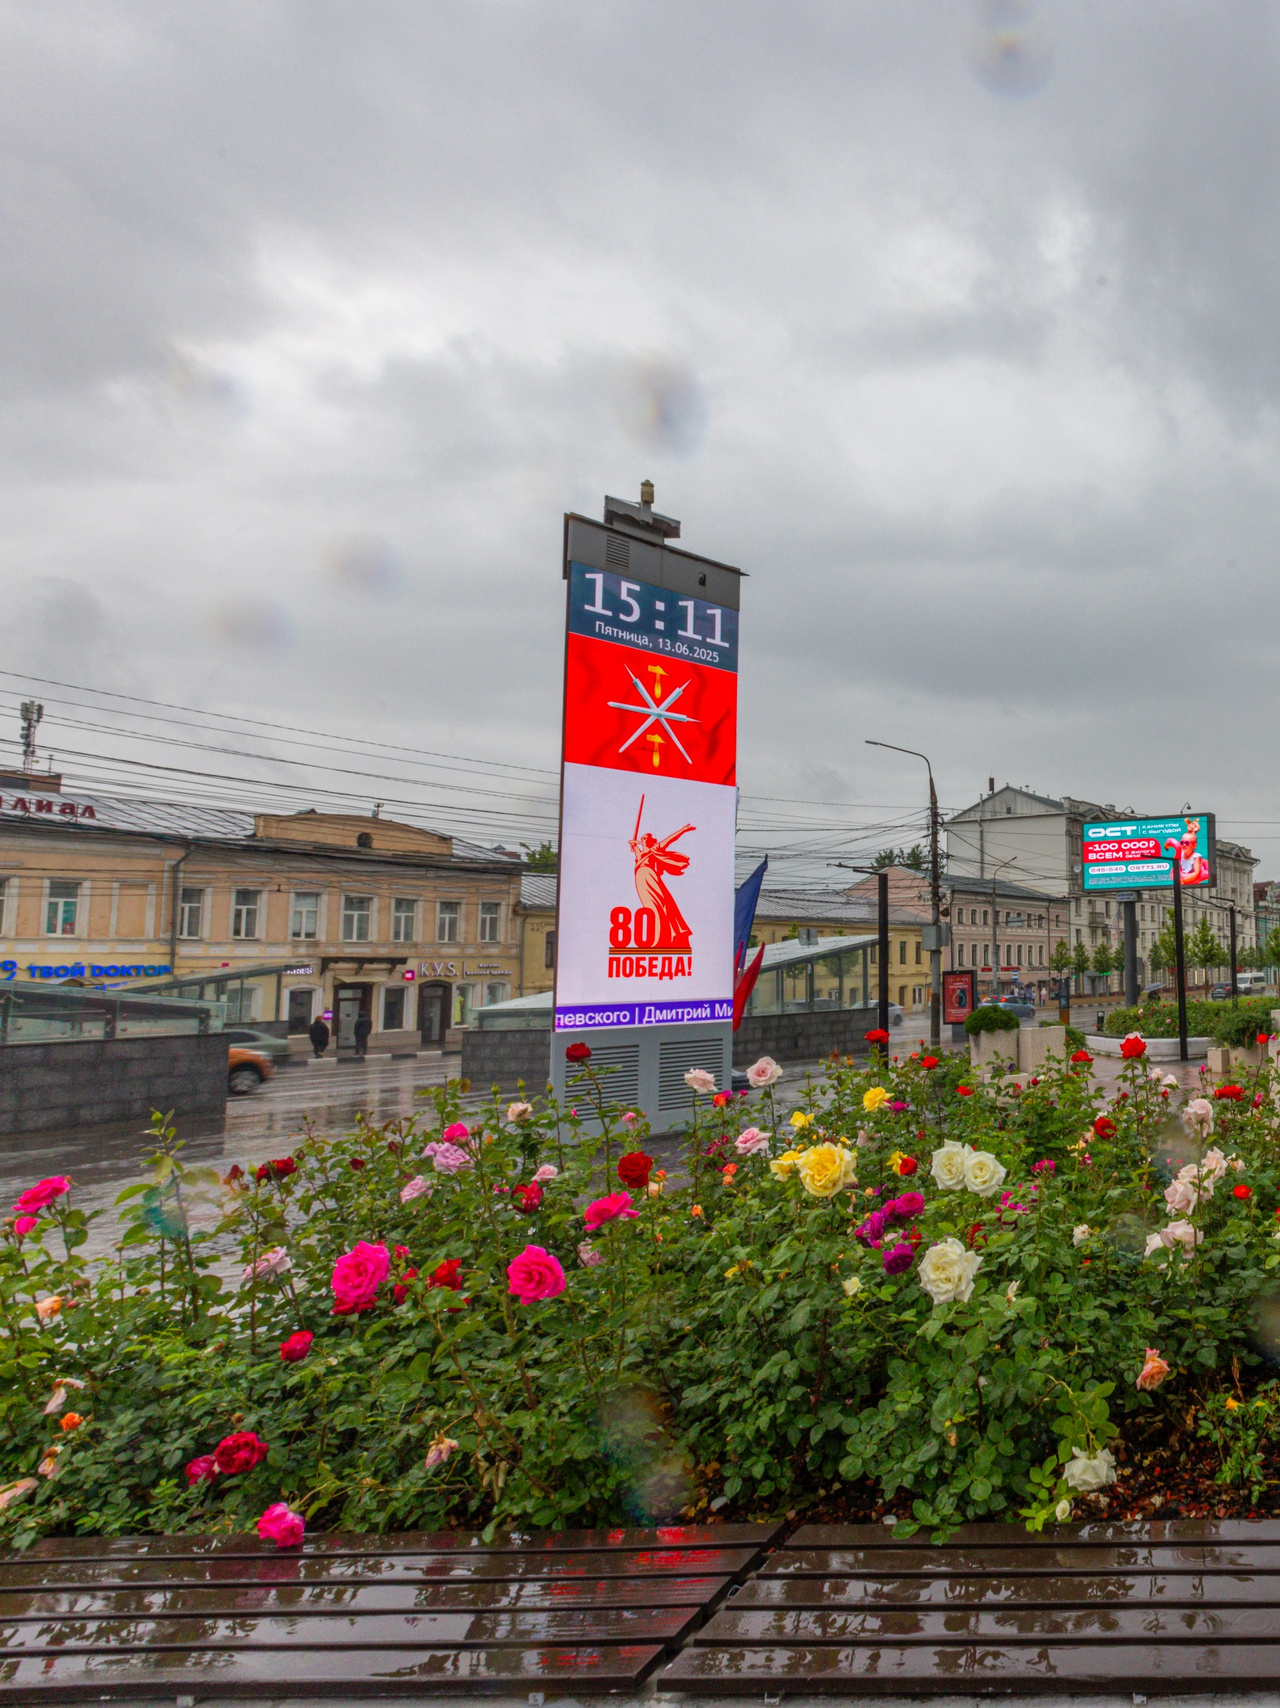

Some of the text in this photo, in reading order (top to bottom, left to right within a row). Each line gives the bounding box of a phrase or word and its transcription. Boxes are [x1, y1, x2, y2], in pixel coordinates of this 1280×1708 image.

[584, 572, 730, 648] 15:11
[595, 620, 720, 663] Пятница, 13.06.2025
[0, 796, 97, 819] лиал
[1088, 826, 1137, 838] ОСТ
[1088, 843, 1118, 851] -100
[1088, 851, 1123, 860] ВСЕМ
[609, 906, 655, 948] 80
[27, 962, 85, 978] ТВОЙ
[608, 956, 692, 980] ПОБЕДА!
[643, 1004, 710, 1024] Дмитрий
